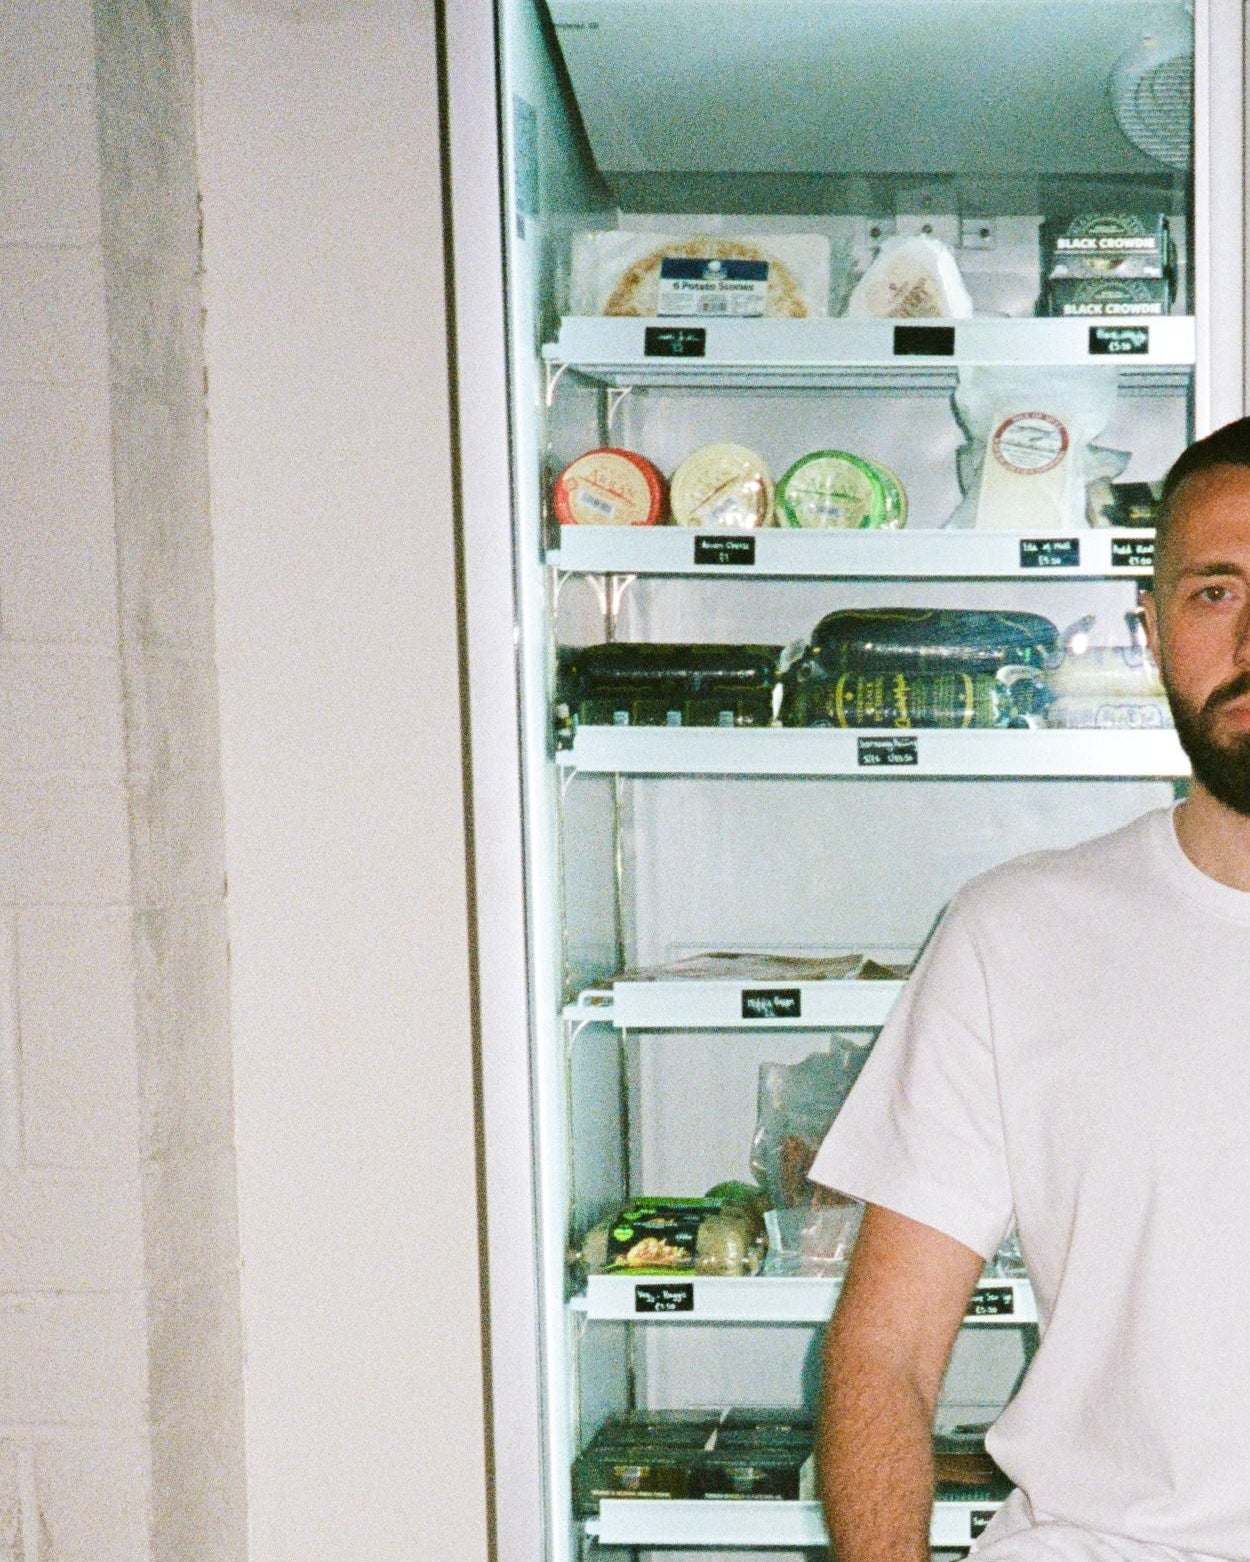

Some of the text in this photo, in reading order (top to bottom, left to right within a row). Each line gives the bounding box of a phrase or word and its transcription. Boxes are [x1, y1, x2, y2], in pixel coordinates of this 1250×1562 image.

[1056, 237, 1156, 250] BLACK CROWDIE
[681, 282, 716, 292] Potato
[718, 282, 755, 292] Scones
[1062, 303, 1162, 315] BLACK CROWDIE
